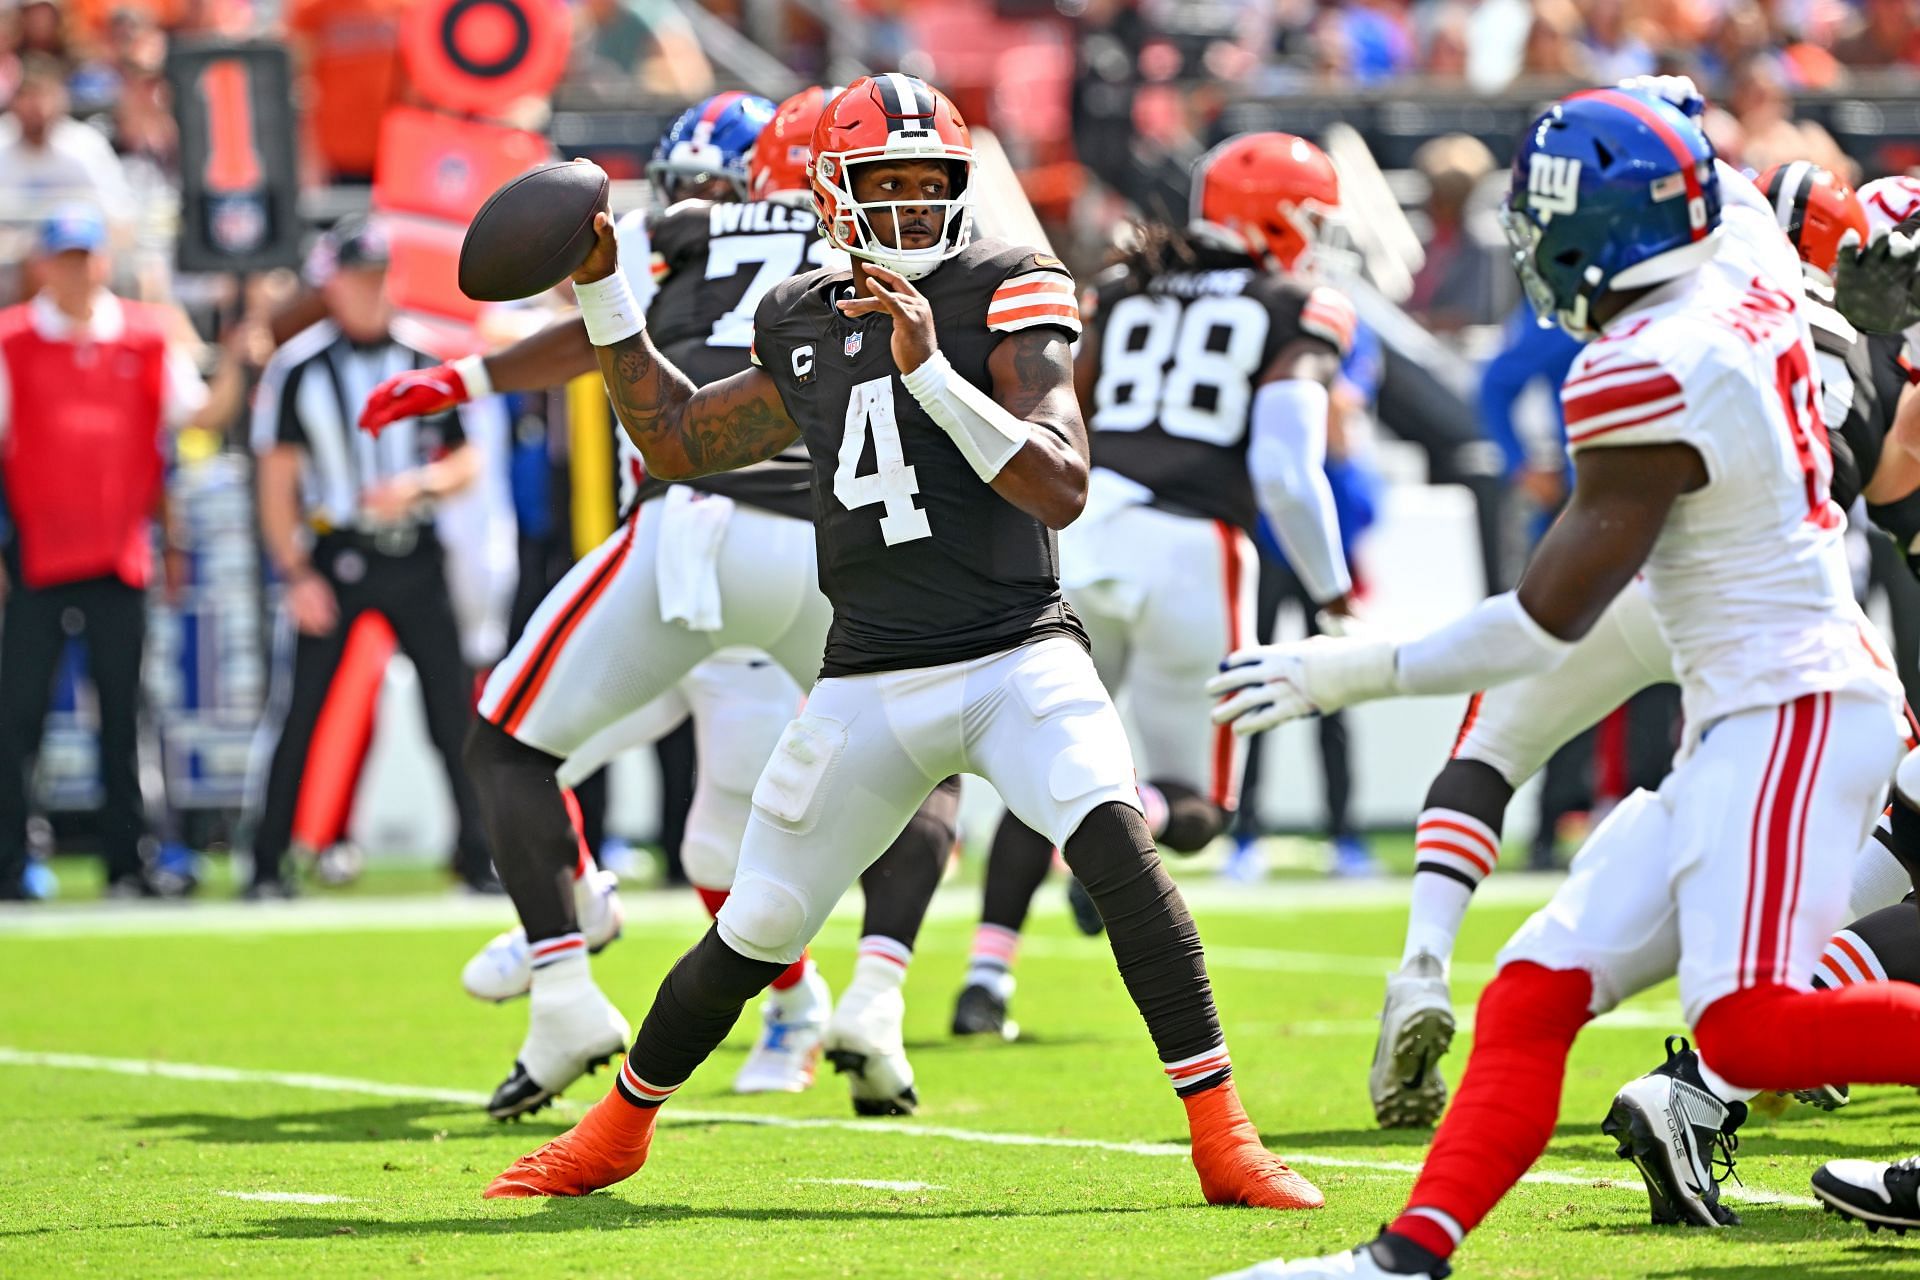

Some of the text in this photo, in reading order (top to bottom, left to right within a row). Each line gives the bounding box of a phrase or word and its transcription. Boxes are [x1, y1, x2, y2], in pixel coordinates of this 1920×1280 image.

[200, 58, 262, 192] 1
[900, 130, 929, 139] BROWNS
[709, 201, 817, 237] WILLS
[704, 231, 853, 348] 7
[791, 344, 814, 377] C
[1090, 293, 1271, 447] 88
[833, 374, 933, 548] 4
[1663, 1108, 1686, 1160] FORCE
